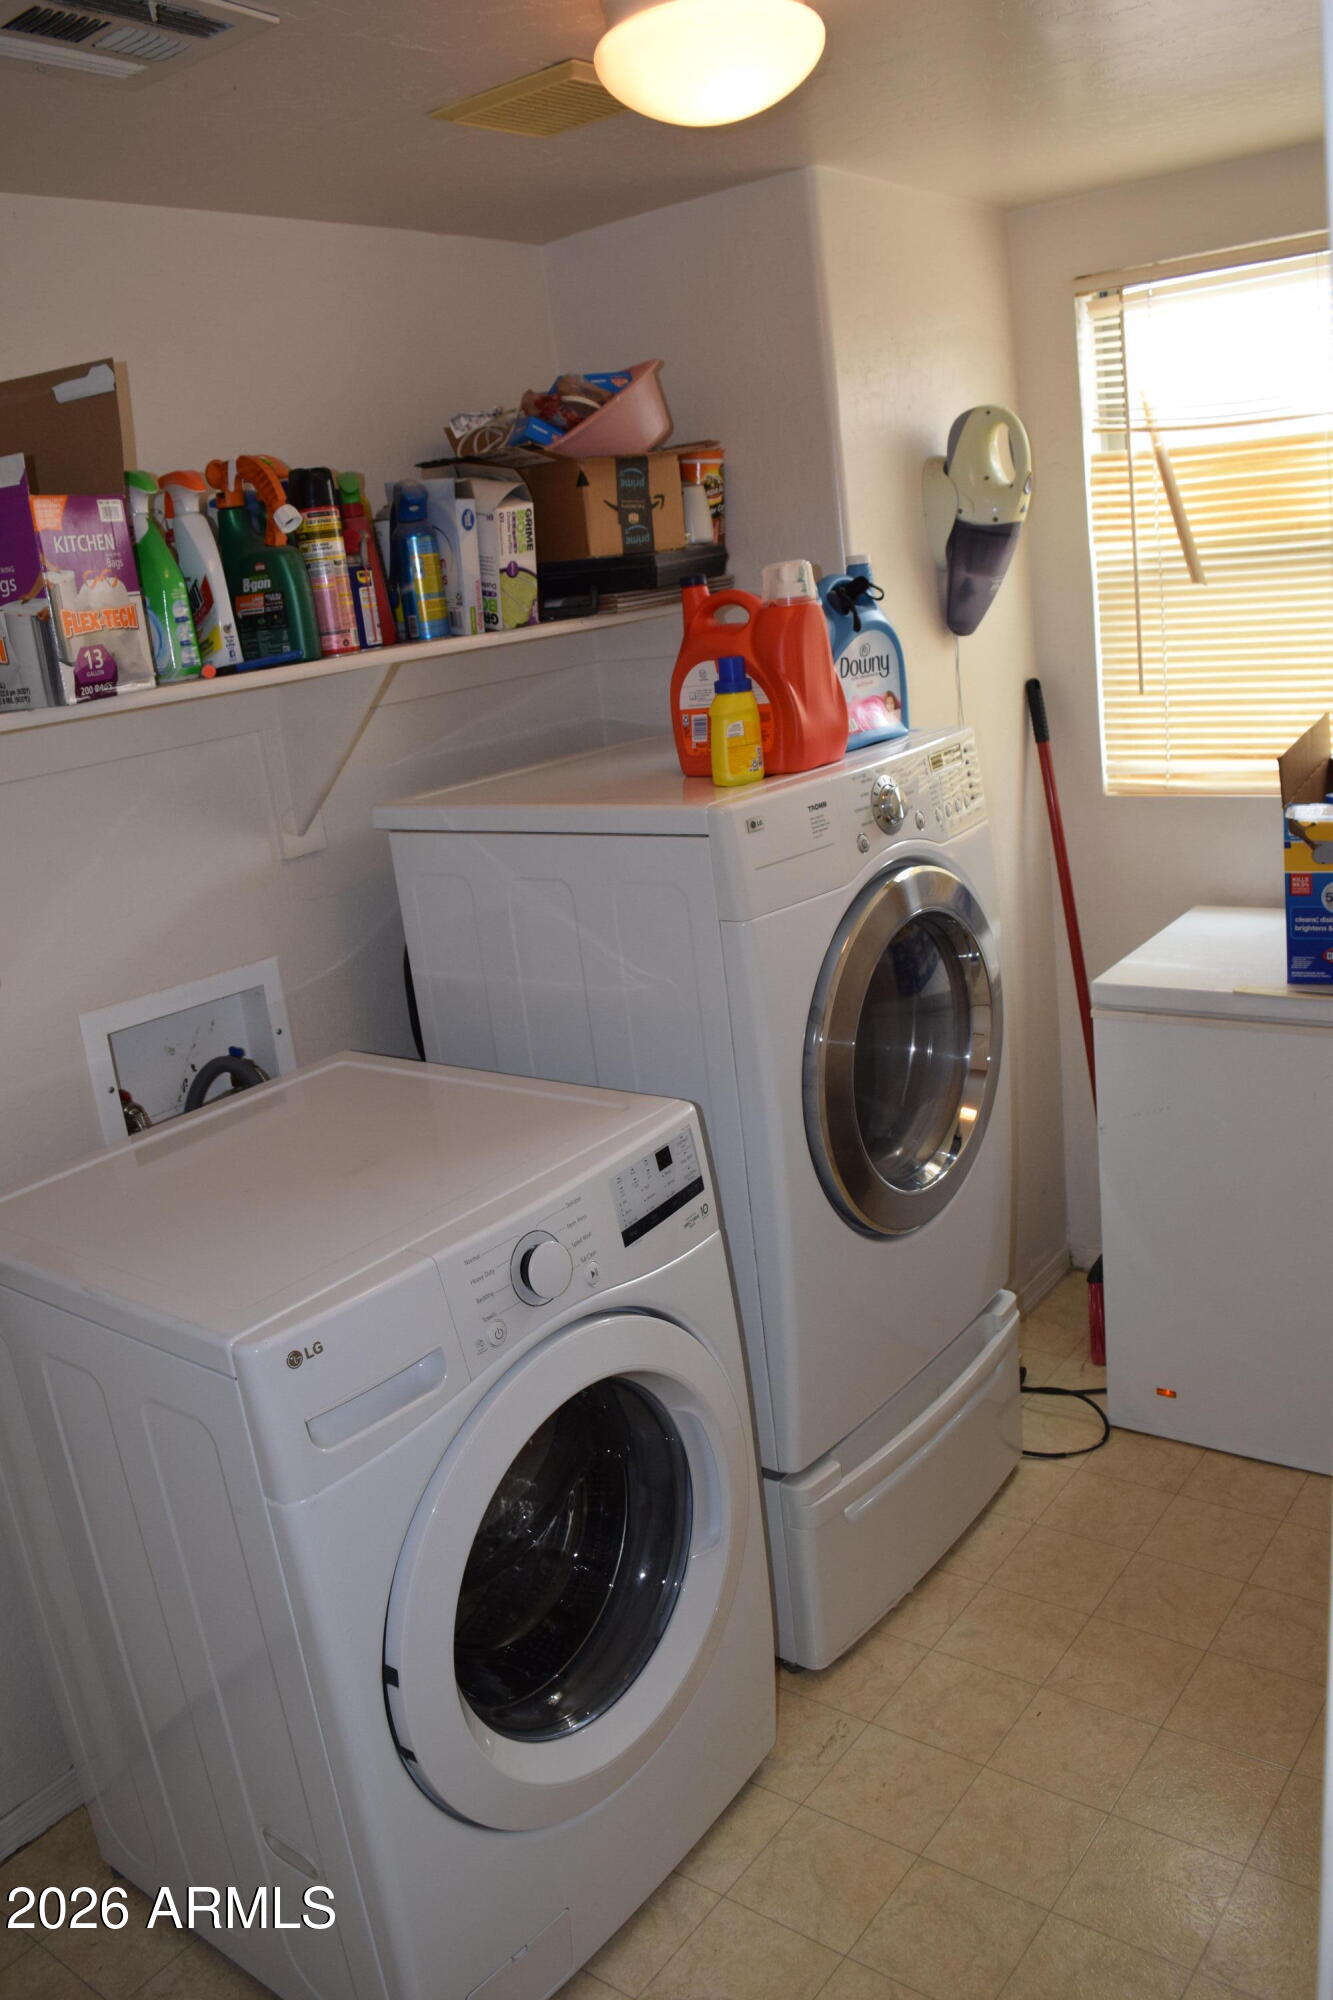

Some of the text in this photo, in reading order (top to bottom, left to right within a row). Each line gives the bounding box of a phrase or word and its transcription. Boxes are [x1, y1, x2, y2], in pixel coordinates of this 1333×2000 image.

[525, 508, 534, 552] GRIME
[53, 534, 115, 554] KITCHEN
[106, 557, 124, 569] Bags
[0, 577, 17, 598] gs
[83, 648, 105, 670] 13
[840, 653, 890, 679] Downy
[80, 684, 94, 696] 200
[464, 1254, 481, 1266] Normal
[304, 1340, 324, 1360] LG
